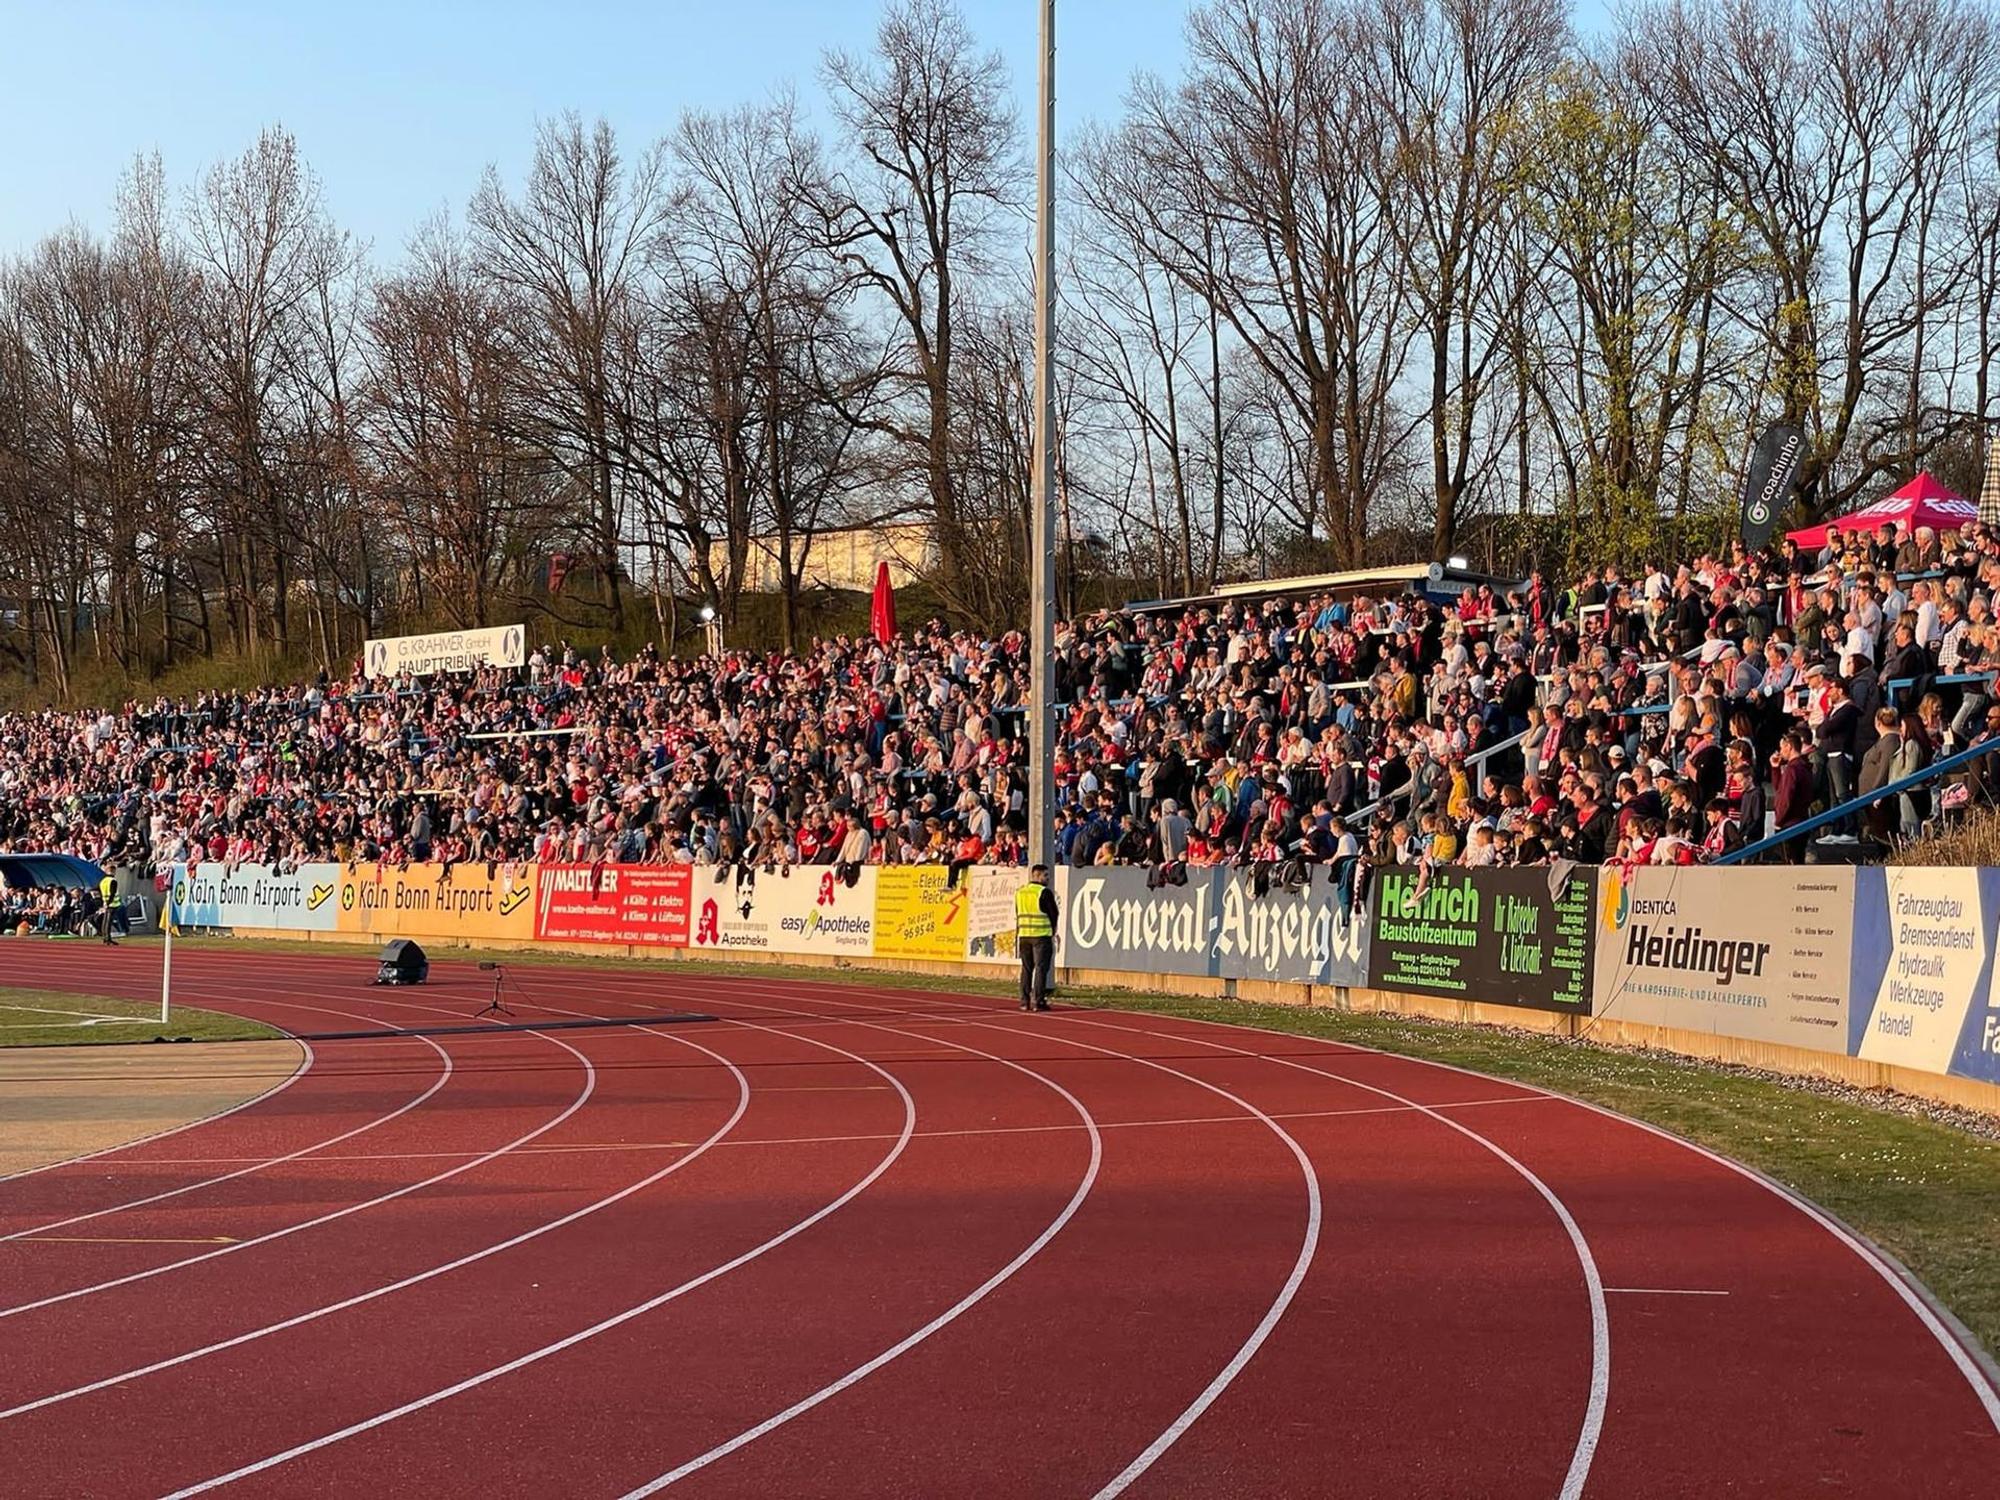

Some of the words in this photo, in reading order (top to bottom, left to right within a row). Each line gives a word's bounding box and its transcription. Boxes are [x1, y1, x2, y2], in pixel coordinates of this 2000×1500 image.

[1761, 435, 1799, 501] coachinho
[399, 650, 490, 673] HAUPTTRIBÜNE
[189, 879, 216, 905] Köln
[220, 880, 248, 905] Bonn
[254, 880, 301, 912] Airport
[554, 870, 618, 892] MALTEER
[359, 882, 388, 908] Köln
[395, 886, 429, 910] Bonn
[435, 884, 493, 916] Airport
[1632, 900, 1676, 915] IDENTICA
[1896, 893, 1963, 922] Fahrzeugbau
[781, 917, 807, 934] easy
[815, 916, 870, 935] Apotheke
[1507, 895, 1538, 939] Ratgeber
[721, 933, 768, 946] Apotheke
[1379, 922, 1478, 947] Baustoffzentrum
[1900, 922, 1976, 951] Bremsendienst
[1500, 935, 1507, 971] &
[1626, 925, 1770, 985] Heidinger
[1898, 951, 1945, 981] Hydraulik
[1400, 963, 1418, 974] Telefon
[1624, 982, 1635, 993] DIE
[1638, 983, 1688, 998] KAROSSERIE-
[1708, 991, 1767, 1008] LACKEXPERTEN
[1889, 979, 1945, 1013] Werkzeuge
[1878, 1010, 1913, 1038] Handel
